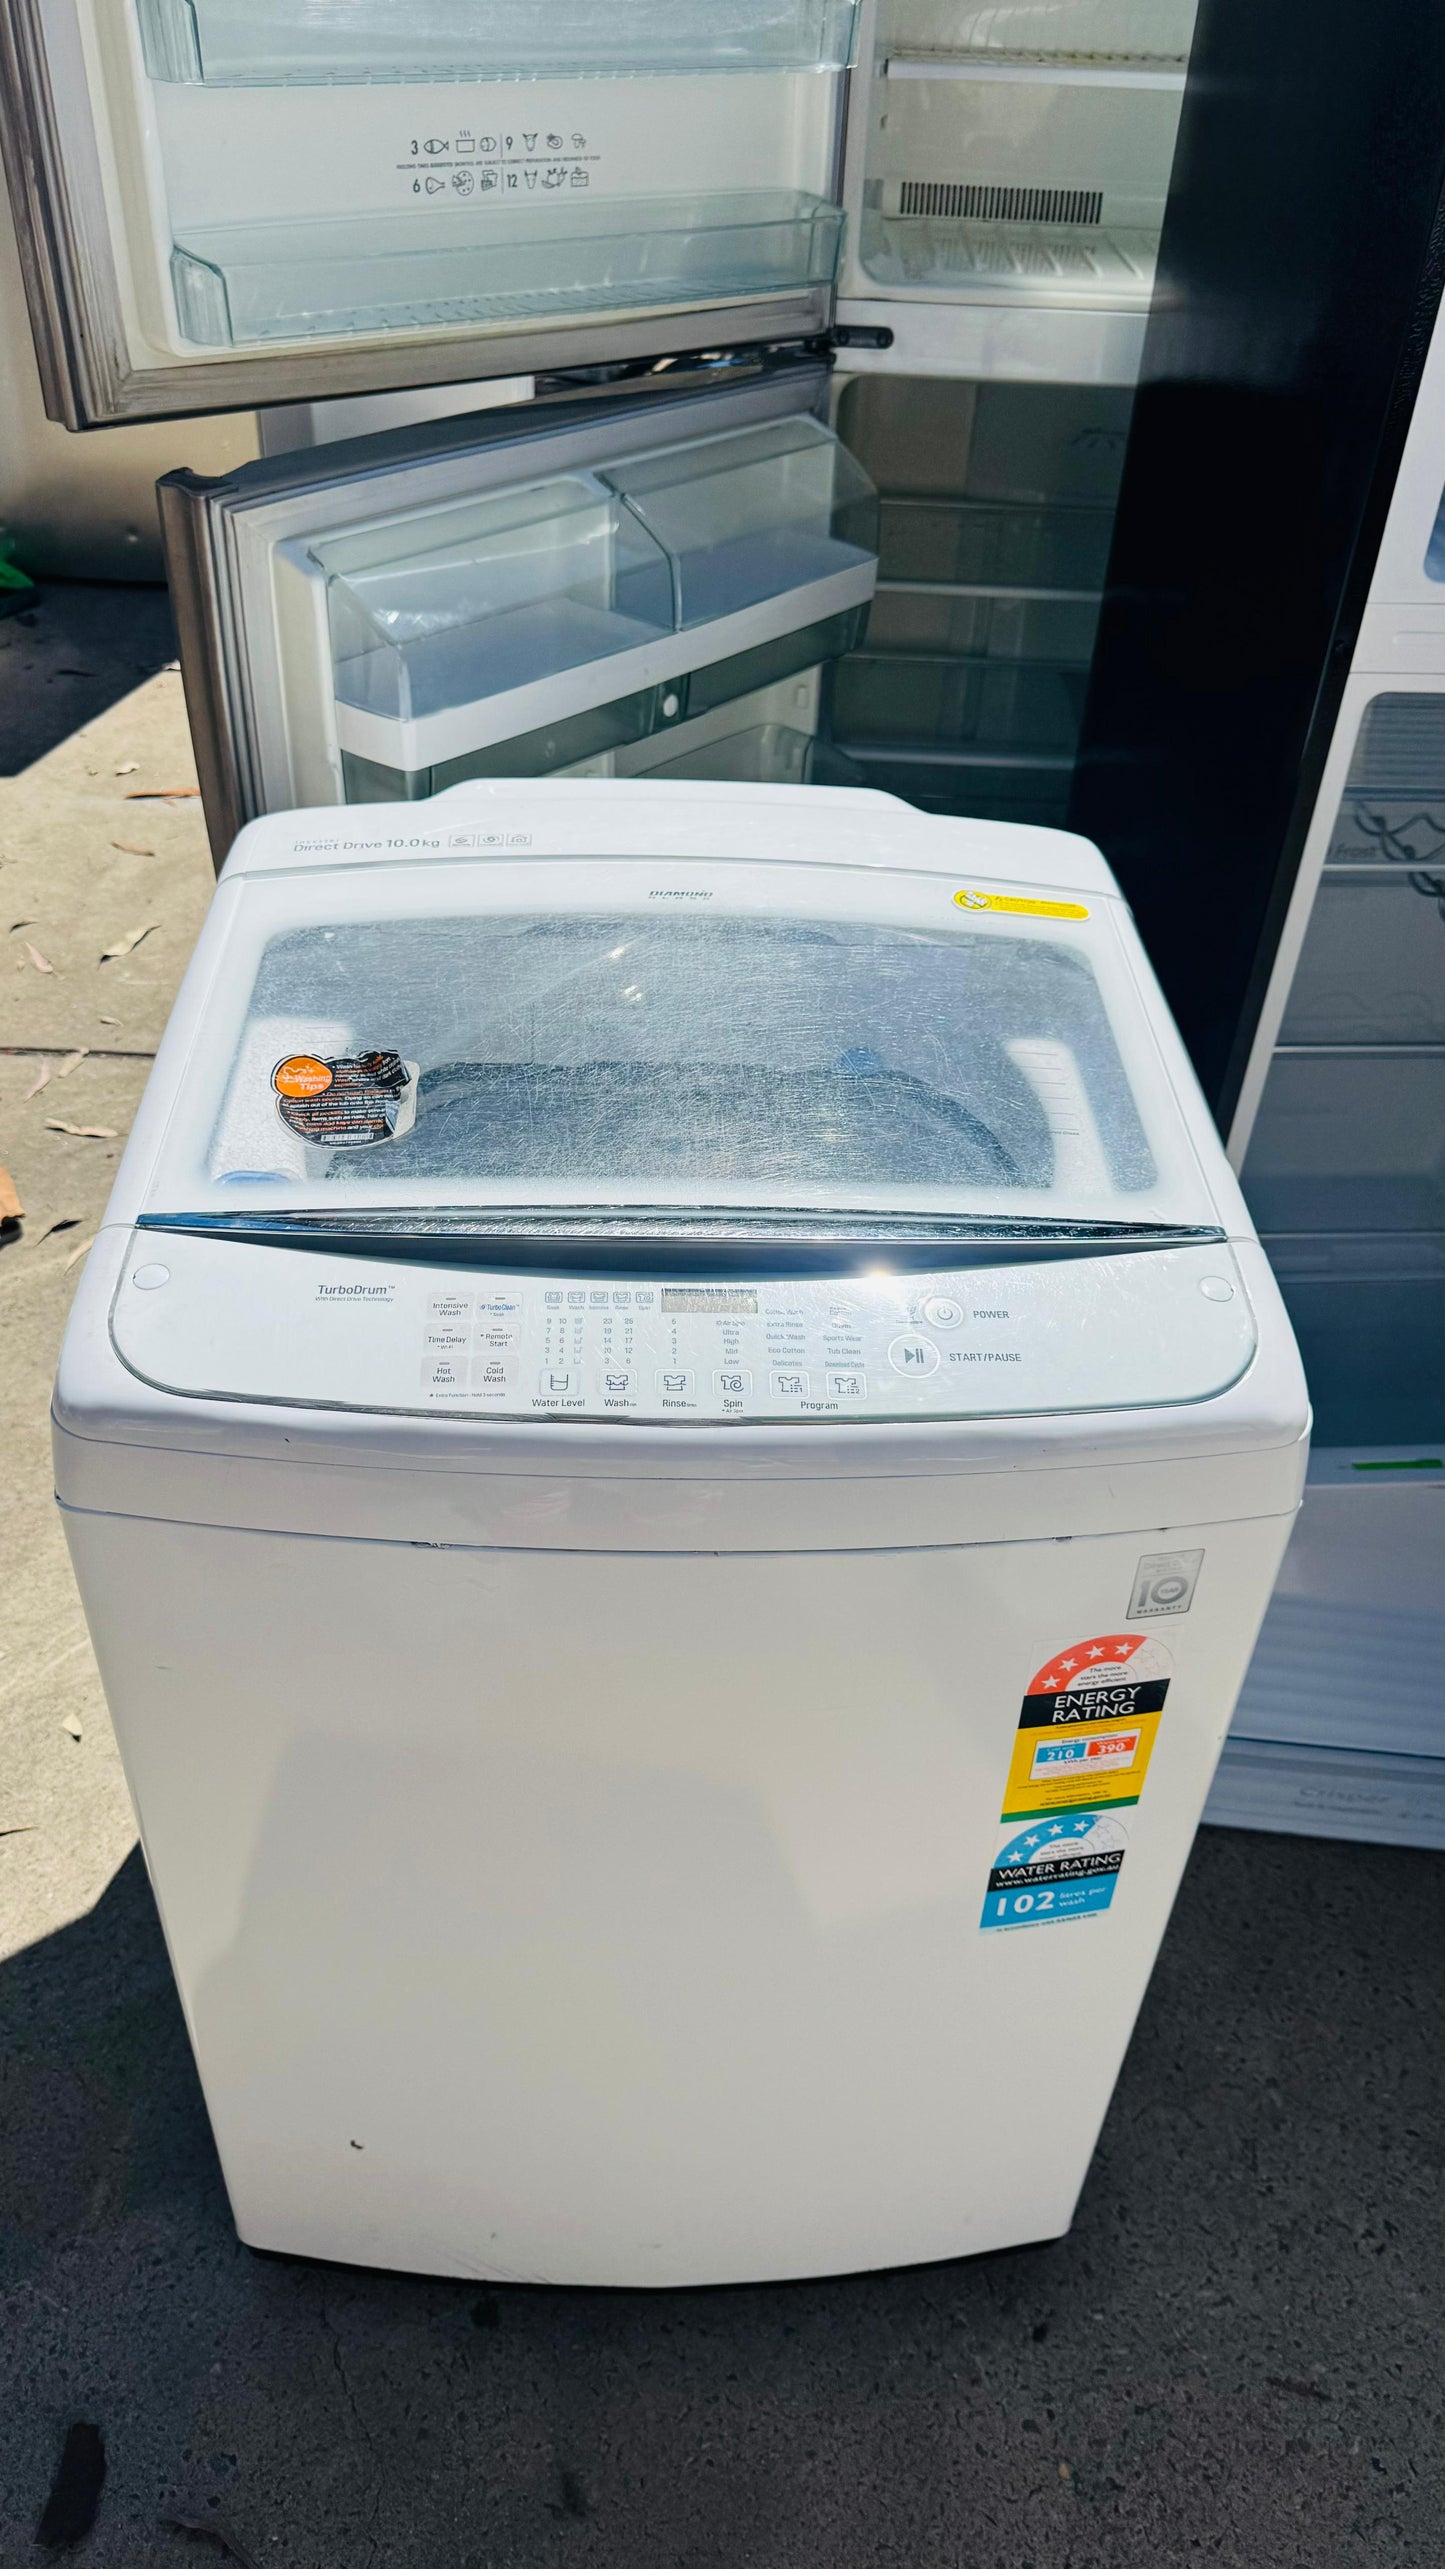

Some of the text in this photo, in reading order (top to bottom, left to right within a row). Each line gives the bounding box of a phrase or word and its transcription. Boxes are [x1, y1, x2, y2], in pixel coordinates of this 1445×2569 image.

[411, 140, 419, 155] 3
[506, 136, 513, 150] 9
[412, 178, 420, 193] 6
[507, 174, 518, 188] 12
[294, 843, 339, 852] Direct
[343, 841, 383, 850] Drive
[300, 1084, 324, 1092] Tips
[973, 1310, 1010, 1318] POWER
[446, 1336, 466, 1344] Delay
[724, 1338, 740, 1346] High
[823, 1334, 844, 1342] Sports
[949, 1353, 1022, 1362] START/PAUSE
[662, 1400, 686, 1408] Rinse
[724, 1400, 743, 1409] Spin
[800, 1401, 839, 1411] Program
[1138, 1576, 1189, 1607] 10
[1054, 1686, 1141, 1709] ENERGY
[1052, 1702, 1136, 1723] RATING
[1097, 1742, 1126, 1754] 390
[1047, 1750, 1075, 1761] 210
[998, 1863, 1056, 1879] WATER
[1060, 1853, 1122, 1872] RATING
[995, 1864, 1120, 1888] www.waterrating.gov.au
[1060, 1888, 1106, 1899] litres per
[996, 1891, 1056, 1917] 102
[1059, 1898, 1086, 1907] wash
